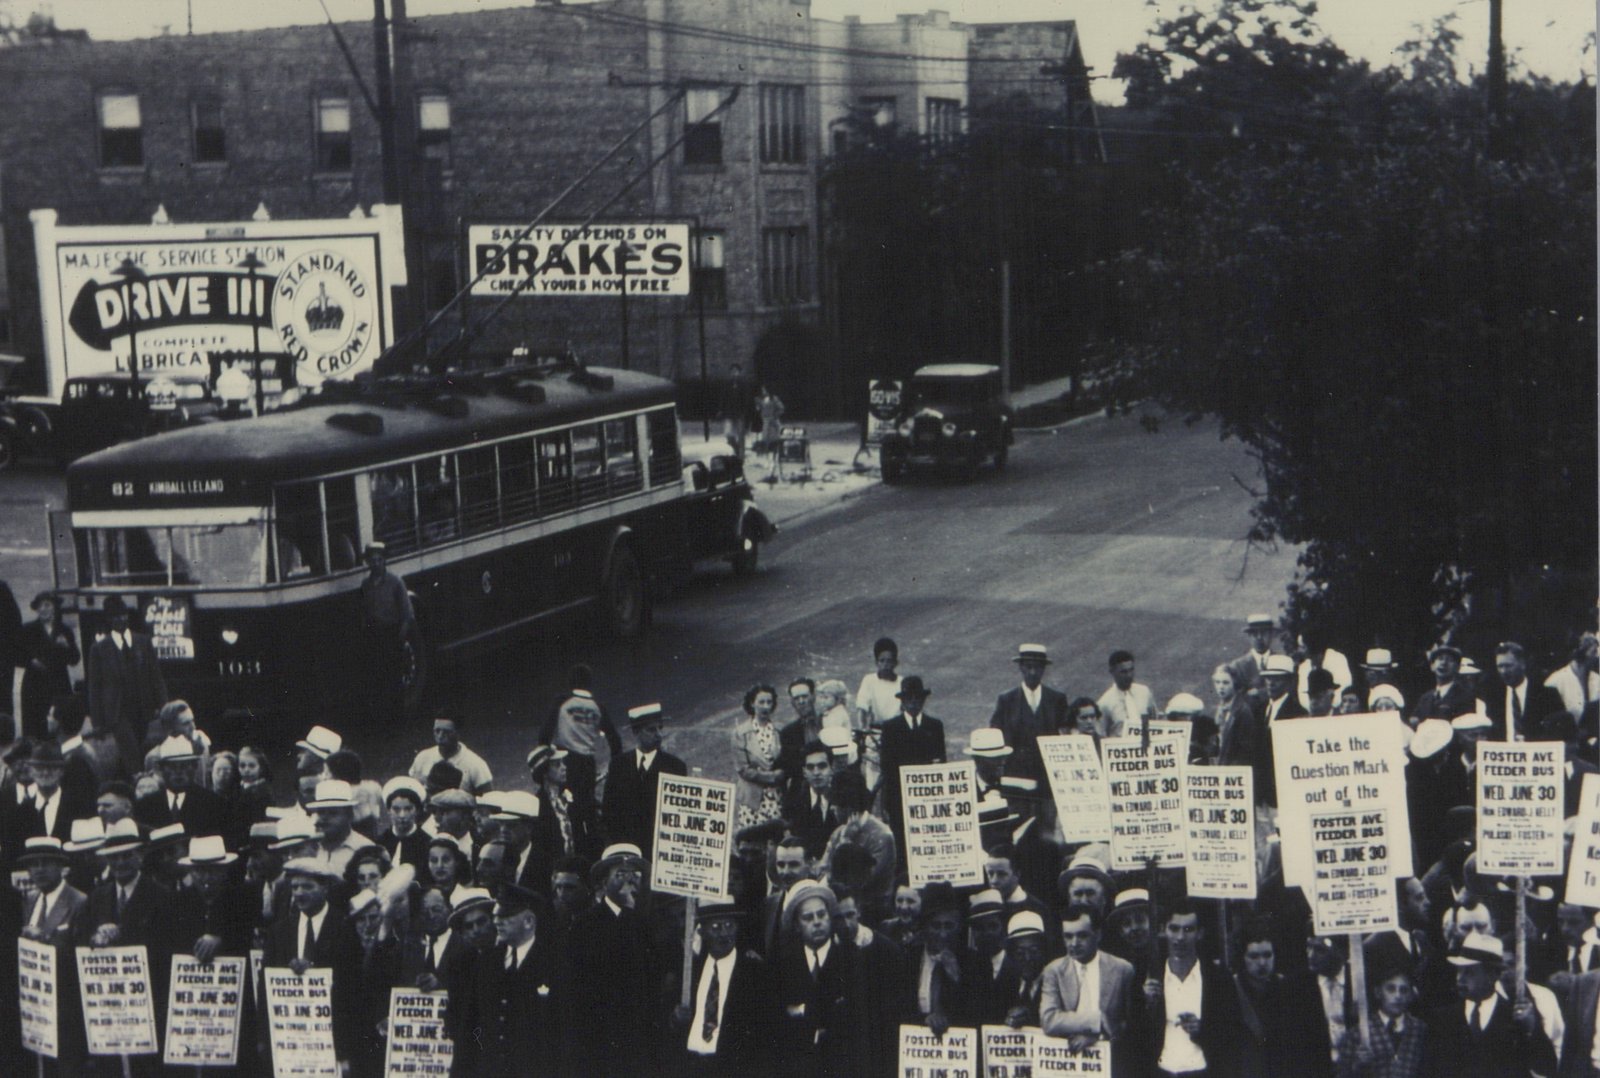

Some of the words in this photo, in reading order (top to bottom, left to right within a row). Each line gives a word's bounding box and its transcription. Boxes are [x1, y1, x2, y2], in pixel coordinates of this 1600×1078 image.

[492, 228, 555, 240] SAFETY
[562, 228, 636, 240] DEPENDS
[643, 227, 667, 239] ON
[65, 250, 148, 269] MAJESTIC
[158, 248, 218, 266] SERVICE
[224, 246, 286, 265] STATION
[476, 243, 683, 275] BRAKES
[280, 253, 365, 300] STANDARD
[490, 279, 537, 291] CHECK
[541, 279, 586, 291] YOURS
[592, 279, 623, 291] NOW
[630, 279, 671, 291] FREE
[94, 277, 210, 330] DRIVE
[143, 335, 228, 347] COMPLETE
[281, 325, 309, 362] RED
[316, 321, 368, 374] CROWN
[149, 481, 185, 495] KIMBALL
[1307, 740, 1341, 754] Take
[1349, 737, 1370, 751] the
[1108, 747, 1148, 759] FOSTER
[1483, 751, 1526, 762] FOSTER
[1110, 760, 1149, 772] FEEDER
[1154, 759, 1175, 769] BUS
[1291, 763, 1349, 780] Question
[1353, 760, 1389, 775] Mark
[1484, 766, 1526, 776] FEEDER
[1532, 766, 1554, 776] BUS
[906, 773, 943, 783] FOSTER
[1187, 776, 1219, 786] FOSTER
[664, 783, 702, 797] FOSTER
[908, 786, 944, 797] FEEDER
[949, 784, 968, 794] BUS
[1134, 779, 1159, 795] JUNE
[1161, 778, 1179, 793] 30
[1509, 785, 1534, 801] JUNE
[1538, 786, 1556, 800] 30
[1188, 790, 1219, 799] FEEDER
[1225, 790, 1244, 799] BUS
[1305, 788, 1327, 803] out
[1335, 786, 1348, 800] of
[1358, 785, 1379, 799] the
[664, 795, 701, 809] FEEDER
[706, 801, 725, 813] BUS
[931, 803, 952, 818] JUNE
[956, 802, 971, 816] 30
[1126, 801, 1152, 812] EDWARD
[1161, 799, 1180, 809] KELLY
[1208, 809, 1227, 824] JUNE
[1230, 810, 1246, 823] 30
[1498, 807, 1525, 817] EDWARD
[1536, 807, 1555, 817] KELLY
[684, 816, 706, 832] JUNE
[710, 821, 725, 835] 30
[922, 824, 947, 834] EDWARD
[955, 822, 972, 832] KELLY
[1313, 817, 1356, 828] FOSTER
[1114, 826, 1141, 836] PULASKI
[1147, 823, 1172, 835] FOSTER
[1316, 829, 1357, 841] FEEDER
[1362, 827, 1384, 838] BUS
[1482, 830, 1511, 840] PULASKI
[1518, 831, 1545, 840] FOSTER
[673, 833, 698, 845] EDWARD
[706, 838, 724, 849] KELLY
[912, 846, 936, 856] PULASKI
[941, 844, 965, 854] FOSTER
[1341, 847, 1366, 862] JUNE
[1369, 845, 1386, 859] 30
[658, 851, 684, 864] PULASKI
[689, 856, 713, 868] FOSTER
[1216, 853, 1238, 862] FOSTER
[1331, 868, 1359, 879] EDWARD
[1368, 865, 1387, 876] KELLY
[1318, 889, 1346, 901] PULASKI
[1352, 888, 1379, 899] FOSTER
[82, 955, 117, 964] FOSTER
[84, 966, 118, 974] FEEDER
[122, 966, 141, 974] BUS
[177, 963, 215, 973] FOSTER
[177, 975, 213, 985] FEEDER
[218, 976, 237, 985] BUS
[270, 977, 303, 986] FOSTER
[108, 982, 125, 994] JUNE
[130, 982, 145, 994] 30
[272, 988, 304, 997] FEEDER
[309, 989, 327, 997] BUS
[198, 991, 218, 1005] JUNE
[222, 992, 237, 1004] 30
[396, 996, 434, 1006] FOSTER
[294, 1005, 311, 1018] JUNE
[315, 1005, 330, 1018] 30
[397, 1008, 433, 1018] FEEDER
[416, 1025, 438, 1039] JUNE
[905, 1035, 943, 1046] FOSTER
[987, 1034, 1026, 1045] FOSTER
[906, 1049, 943, 1060] FEEDER
[950, 1051, 967, 1060] BUS
[989, 1047, 1026, 1058] FEEDER
[1038, 1046, 1077, 1059] FOSTER
[1039, 1060, 1076, 1071] FEEDER
[1082, 1061, 1102, 1072] BUS
